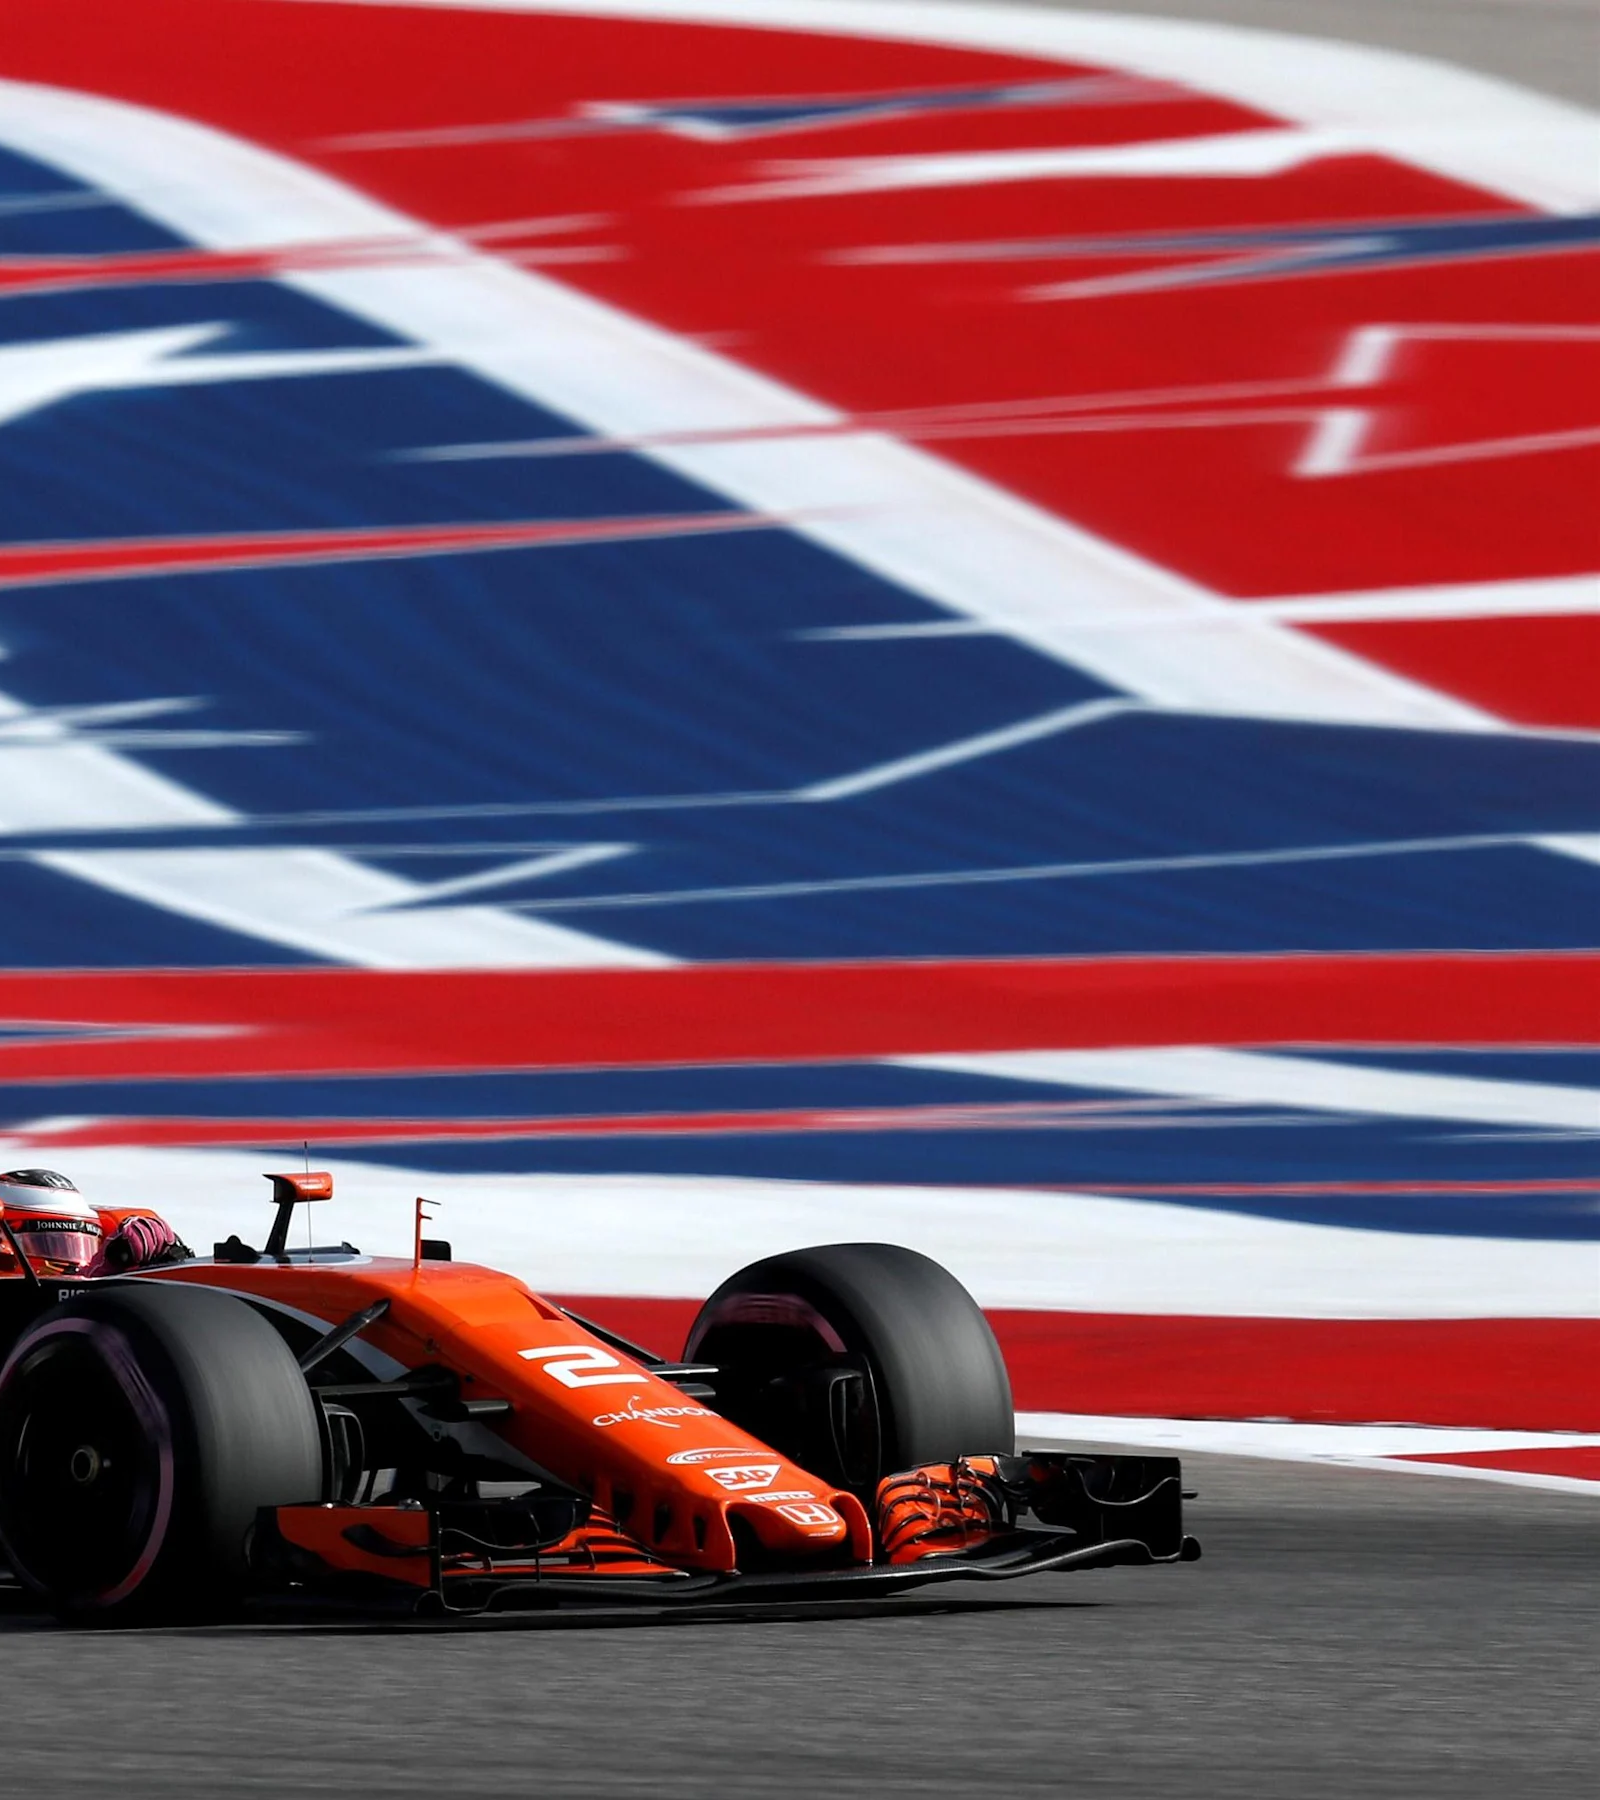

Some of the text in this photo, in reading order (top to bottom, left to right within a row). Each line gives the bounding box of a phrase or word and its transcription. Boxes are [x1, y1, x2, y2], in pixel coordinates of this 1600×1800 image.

[37, 1221, 78, 1231] JOHNNIE
[517, 1346, 649, 1388] 2
[713, 1469, 772, 1485] SAP
